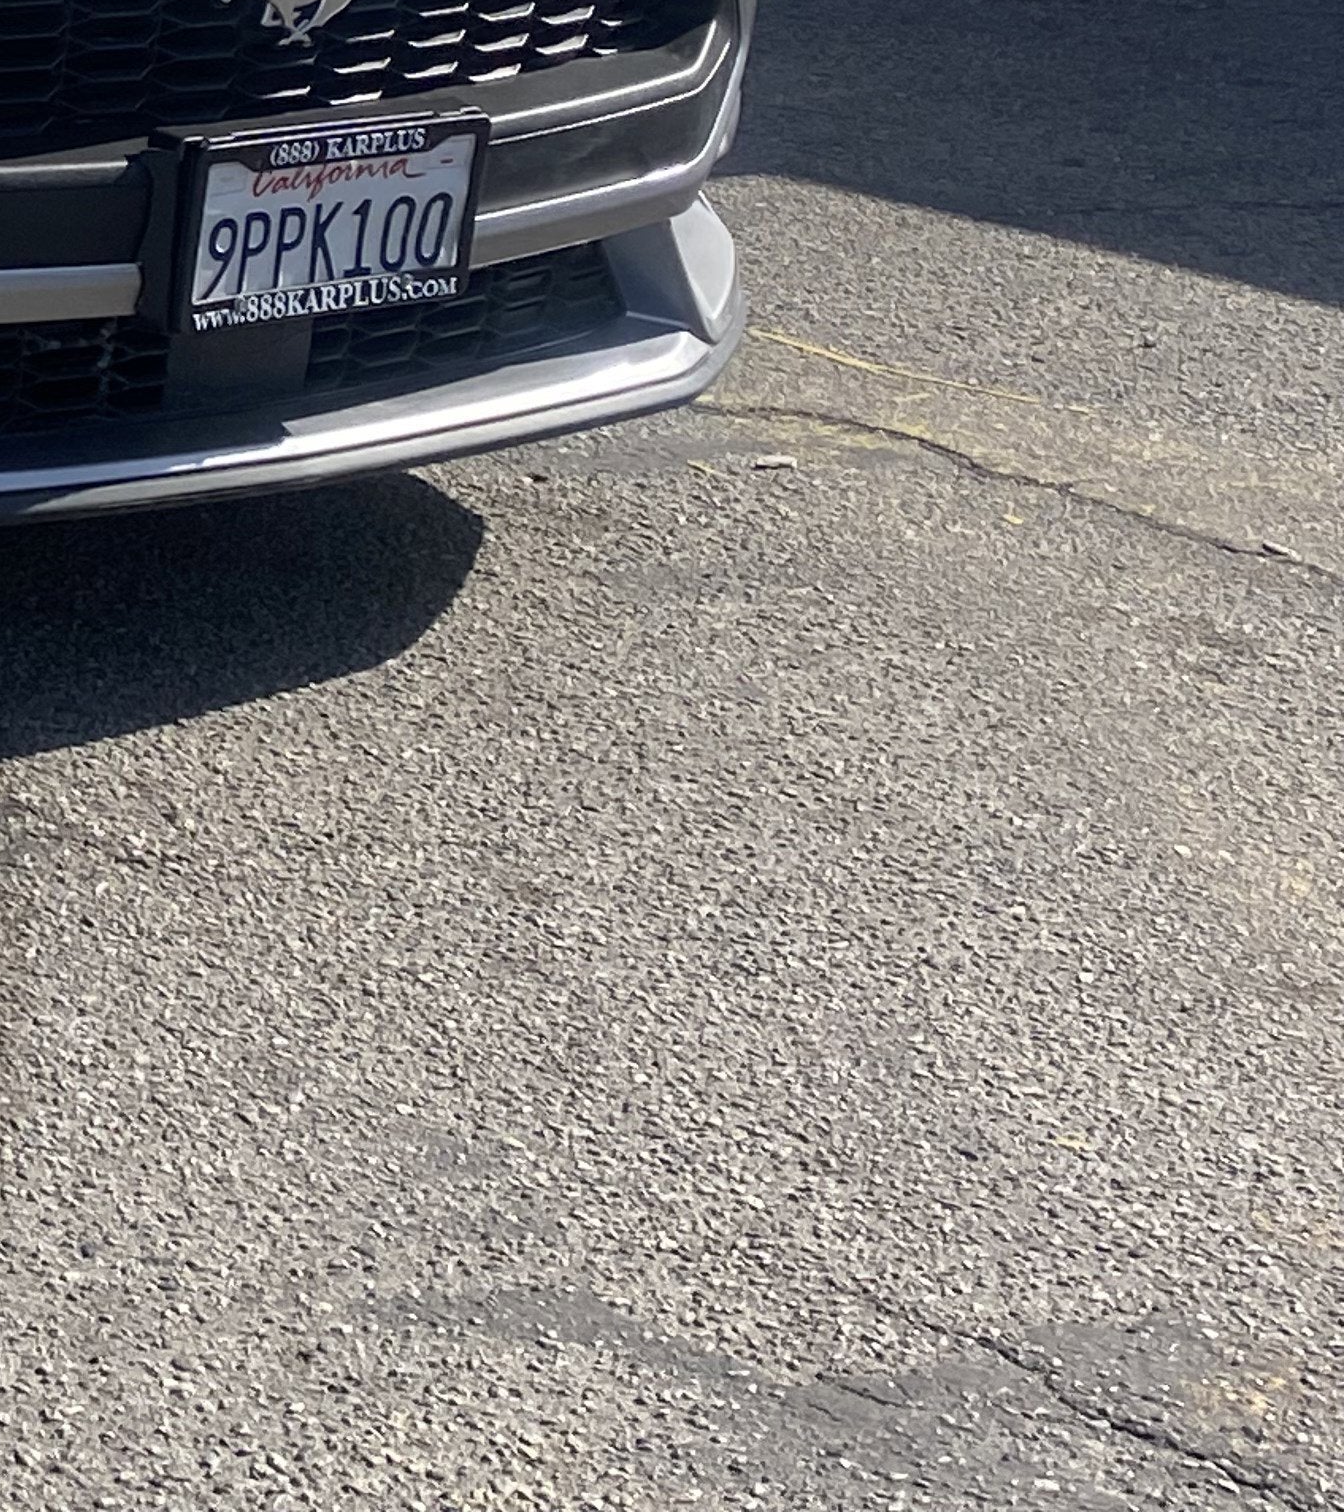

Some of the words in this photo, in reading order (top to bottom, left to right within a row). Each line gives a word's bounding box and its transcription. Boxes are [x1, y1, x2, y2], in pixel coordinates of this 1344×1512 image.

[269, 142, 320, 167] (888)
[326, 127, 426, 160] KARPLUS
[252, 156, 425, 202] California
[196, 191, 454, 300] 9PPK100
